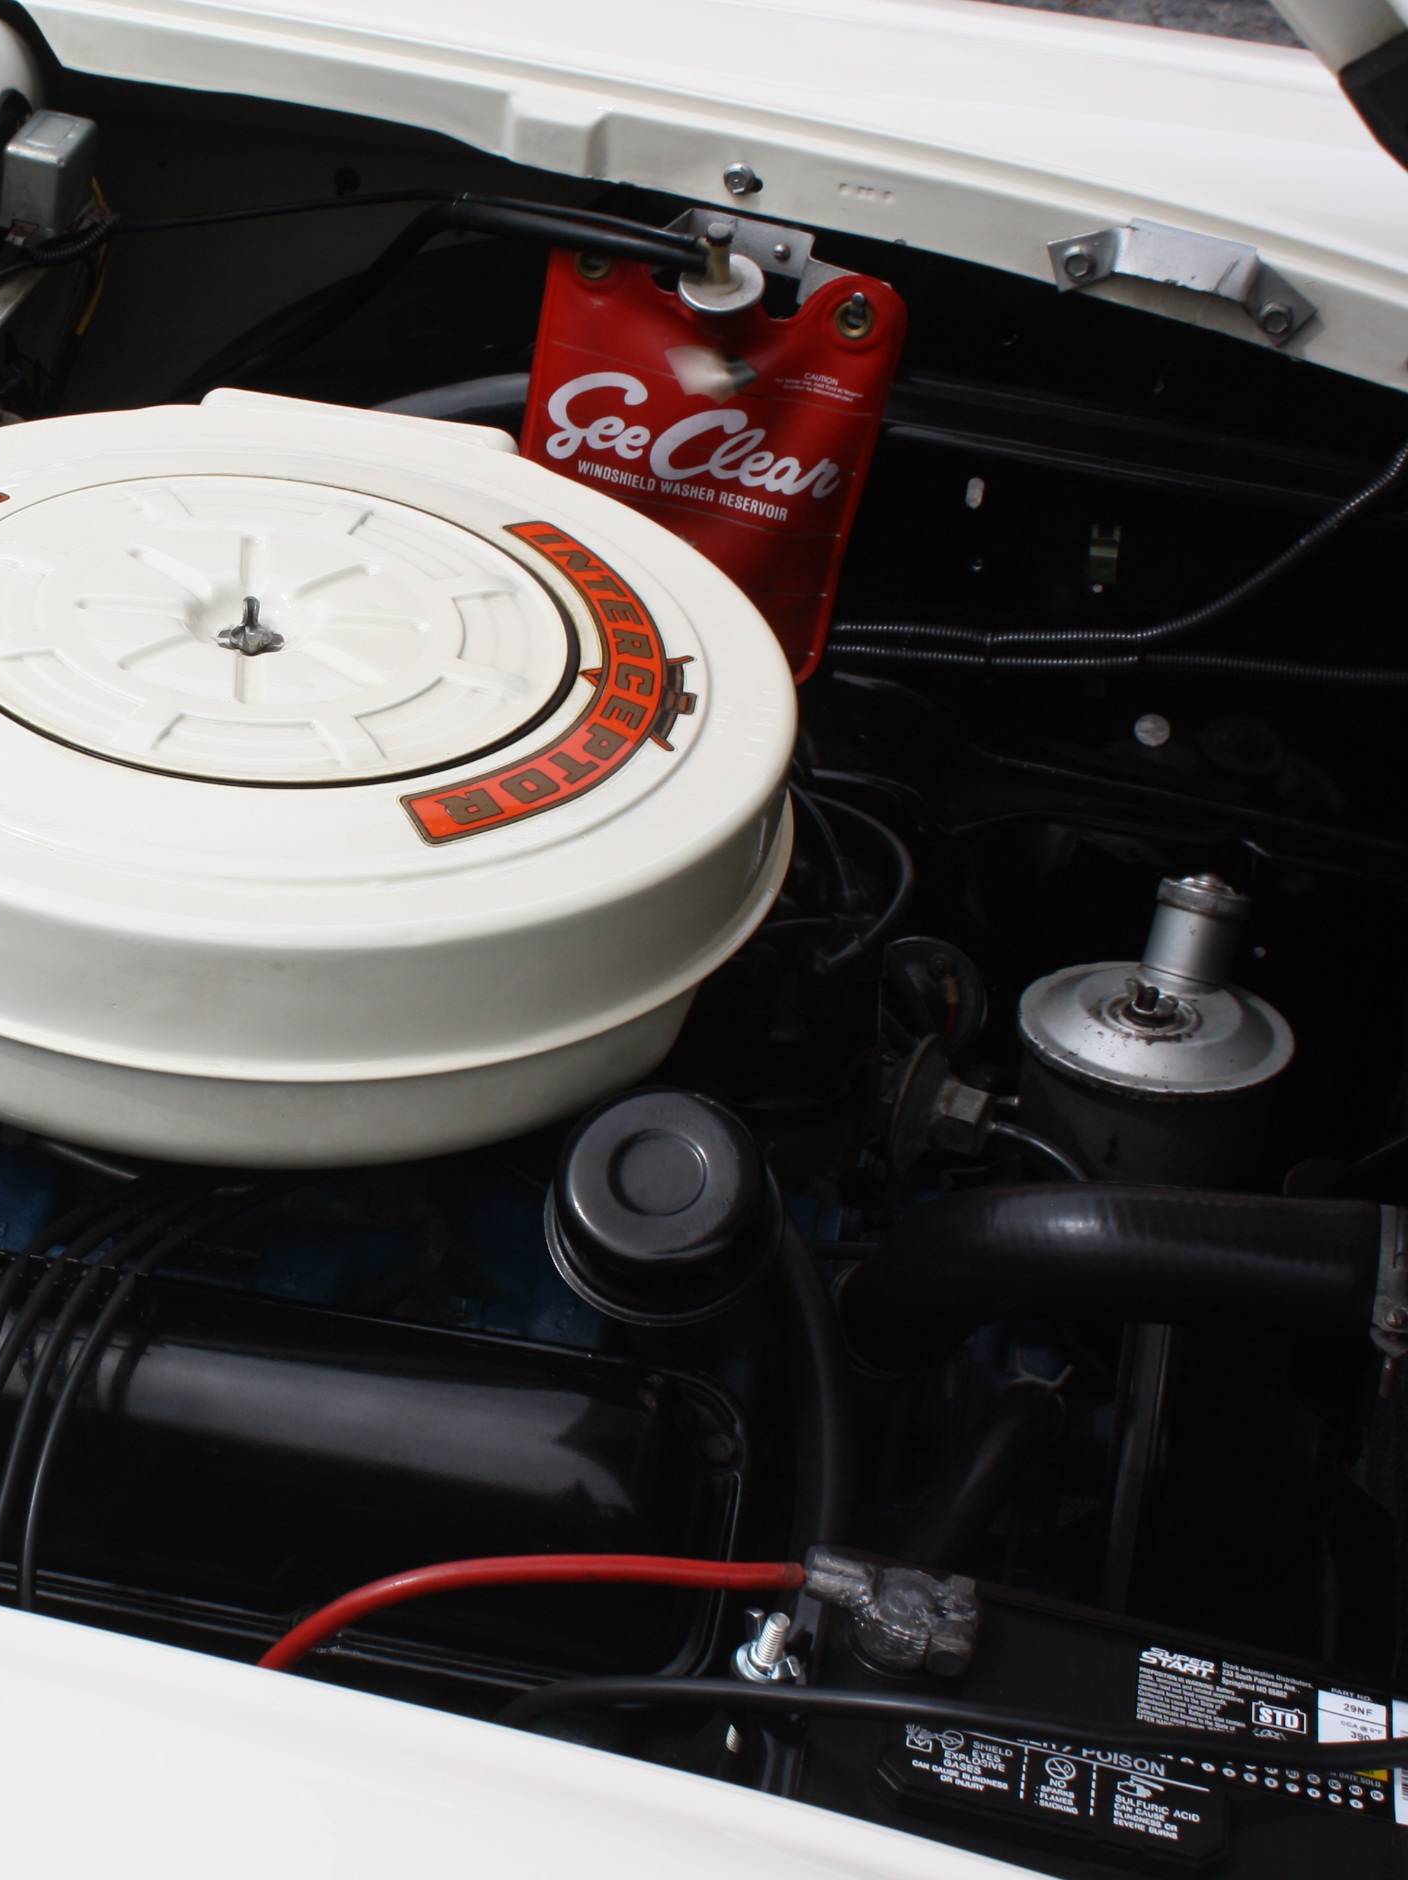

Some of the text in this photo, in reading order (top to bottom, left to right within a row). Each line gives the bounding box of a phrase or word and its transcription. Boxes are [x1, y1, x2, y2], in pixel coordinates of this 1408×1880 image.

[805, 372, 839, 386] CAUTION
[546, 372, 841, 498] See Clear
[577, 459, 788, 520] WINDSHIELD WASHER RESERVOIR
[435, 529, 658, 823] INTERCEPTOR
[1139, 1651, 1214, 1678] START
[1151, 1647, 1216, 1669] SUPER
[1222, 1661, 1238, 1671] Ozark
[1240, 1665, 1274, 1679] Automotive
[1222, 1667, 1233, 1677] 233
[1234, 1670, 1252, 1681] South
[1253, 1675, 1282, 1688] Patterson
[1221, 1676, 1254, 1691] Springfield
[1256, 1684, 1266, 1693] MO
[1331, 1687, 1354, 1698] PART
[1259, 1707, 1298, 1729] STD
[1344, 1703, 1373, 1717] 29NF
[972, 1750, 1001, 1762] EYES
[973, 1741, 1013, 1757] SHIELD
[943, 1759, 981, 1774] GASES
[945, 1750, 1005, 1772] EXPLOSIVE
[1082, 1748, 1165, 1776] POISON
[912, 1760, 1008, 1789] CAN CAUSE BLINDNESS
[1050, 1778, 1066, 1788] NO
[955, 1779, 984, 1791] INJURY
[1041, 1785, 1074, 1799] SPARKS
[1039, 1799, 1078, 1814] SMOKING
[1040, 1792, 1073, 1805] FLAMES
[1114, 1803, 1164, 1821] CAN CAUSE
[1115, 1794, 1200, 1822] SULFURIC ACID
[1113, 1818, 1177, 1839] SEVERE BURNS
[1114, 1810, 1177, 1832] BLINDNESS OR
